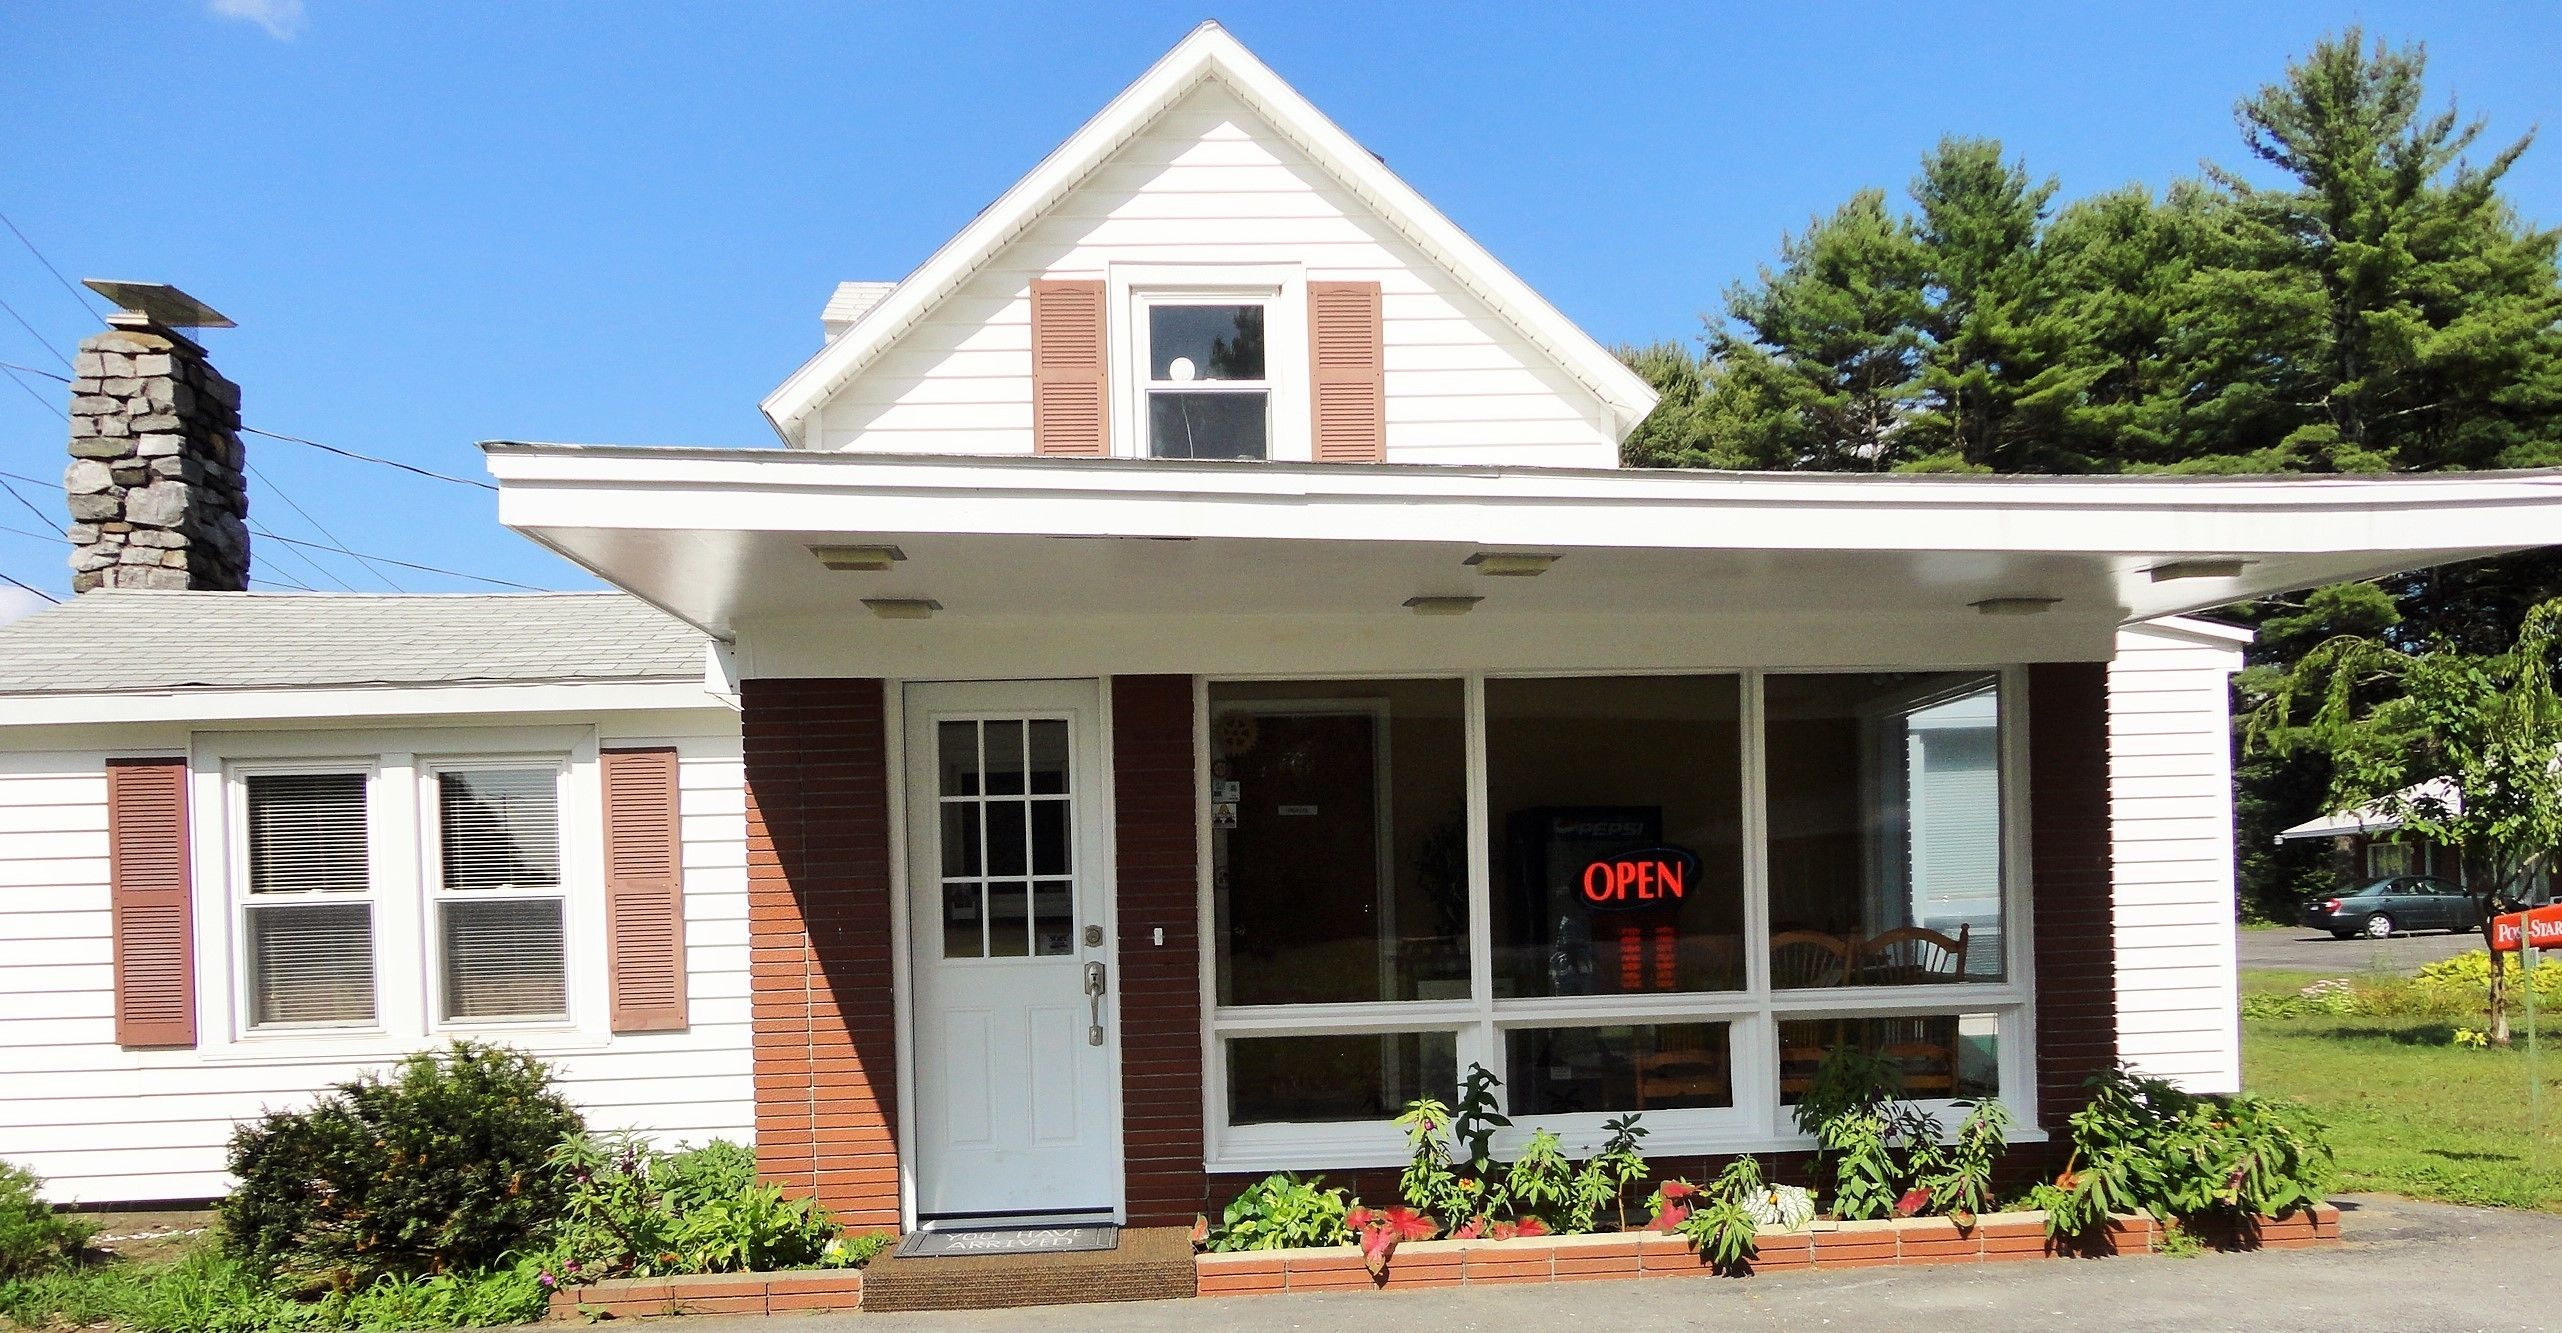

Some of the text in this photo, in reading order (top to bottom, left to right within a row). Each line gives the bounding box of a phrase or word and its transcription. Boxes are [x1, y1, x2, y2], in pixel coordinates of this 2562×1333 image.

[1584, 861, 1682, 901] OPEN
[2497, 919, 2562, 942] POS-STAR
[945, 1237, 1073, 1250] ARRIVED
[946, 1228, 1082, 1241] YOU HAVE
